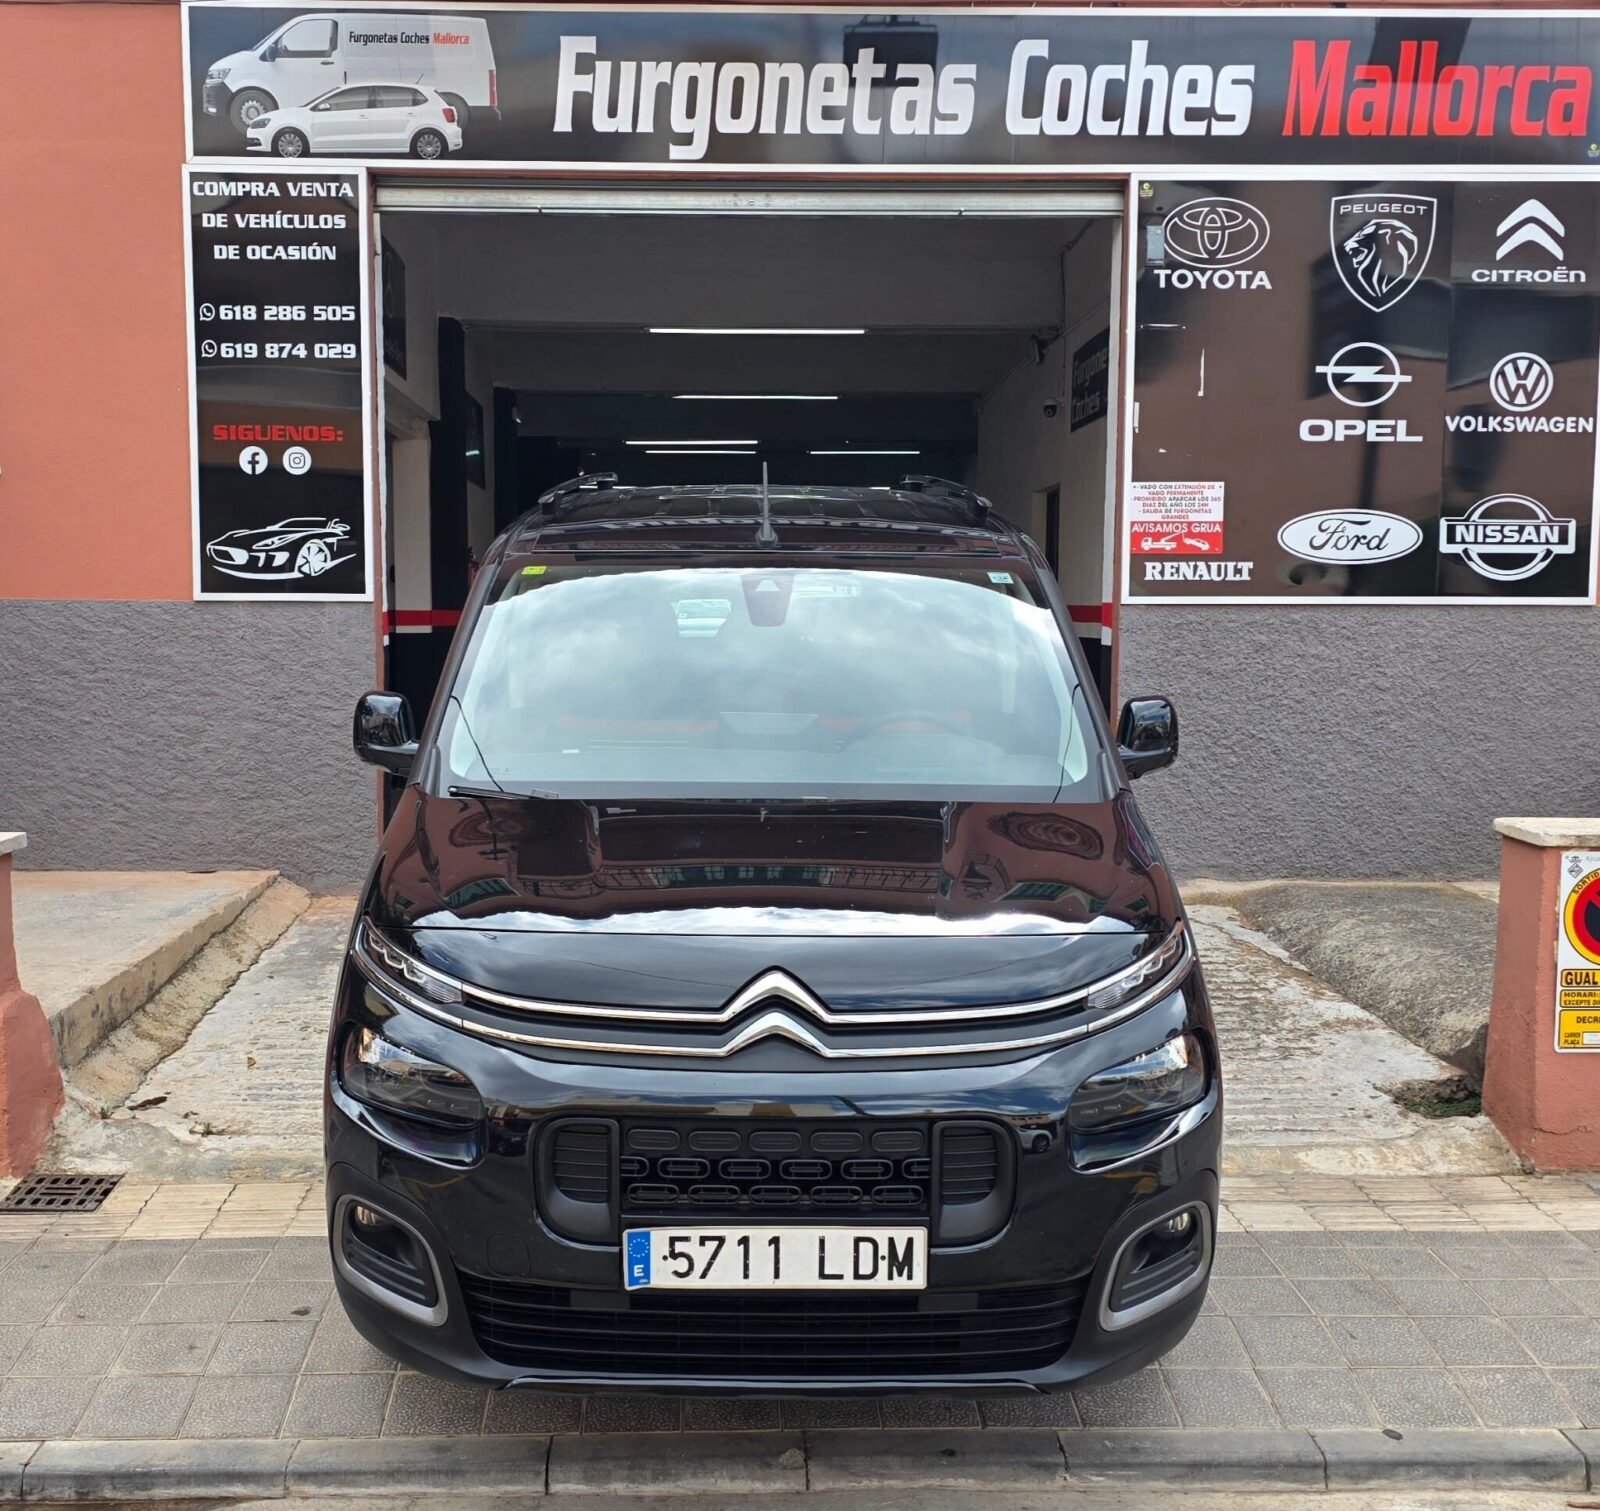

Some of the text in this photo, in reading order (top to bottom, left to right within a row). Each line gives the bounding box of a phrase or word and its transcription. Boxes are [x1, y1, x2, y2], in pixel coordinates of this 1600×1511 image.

[349, 31, 470, 46] Furgonetas Coches Mallorca
[553, 35, 1593, 160] Furgonetas Coches Mallorca
[192, 181, 355, 198] COMPRA VENTA
[1339, 203, 1428, 216] PEUGEOT
[201, 210, 347, 229] DE VEHÍCULOS
[213, 242, 337, 261] DE OCASIÓN
[1154, 269, 1273, 291] TOYOTA
[219, 305, 356, 321] 618 286 505
[220, 343, 357, 359] 619 874 029
[213, 424, 344, 442] SIGUENOS:
[1299, 419, 1423, 443] OPEL
[1445, 415, 1594, 433] VOLKSWAGEN
[1132, 523, 1222, 533] AVISAMOS GRUA
[1309, 518, 1391, 551] Ford
[1455, 524, 1560, 544] NISSAN
[1144, 561, 1253, 581] RENAULT
[1565, 972, 1598, 985] GUAL
[668, 1235, 914, 1281] 5711 LDM
[634, 1264, 644, 1276] E
